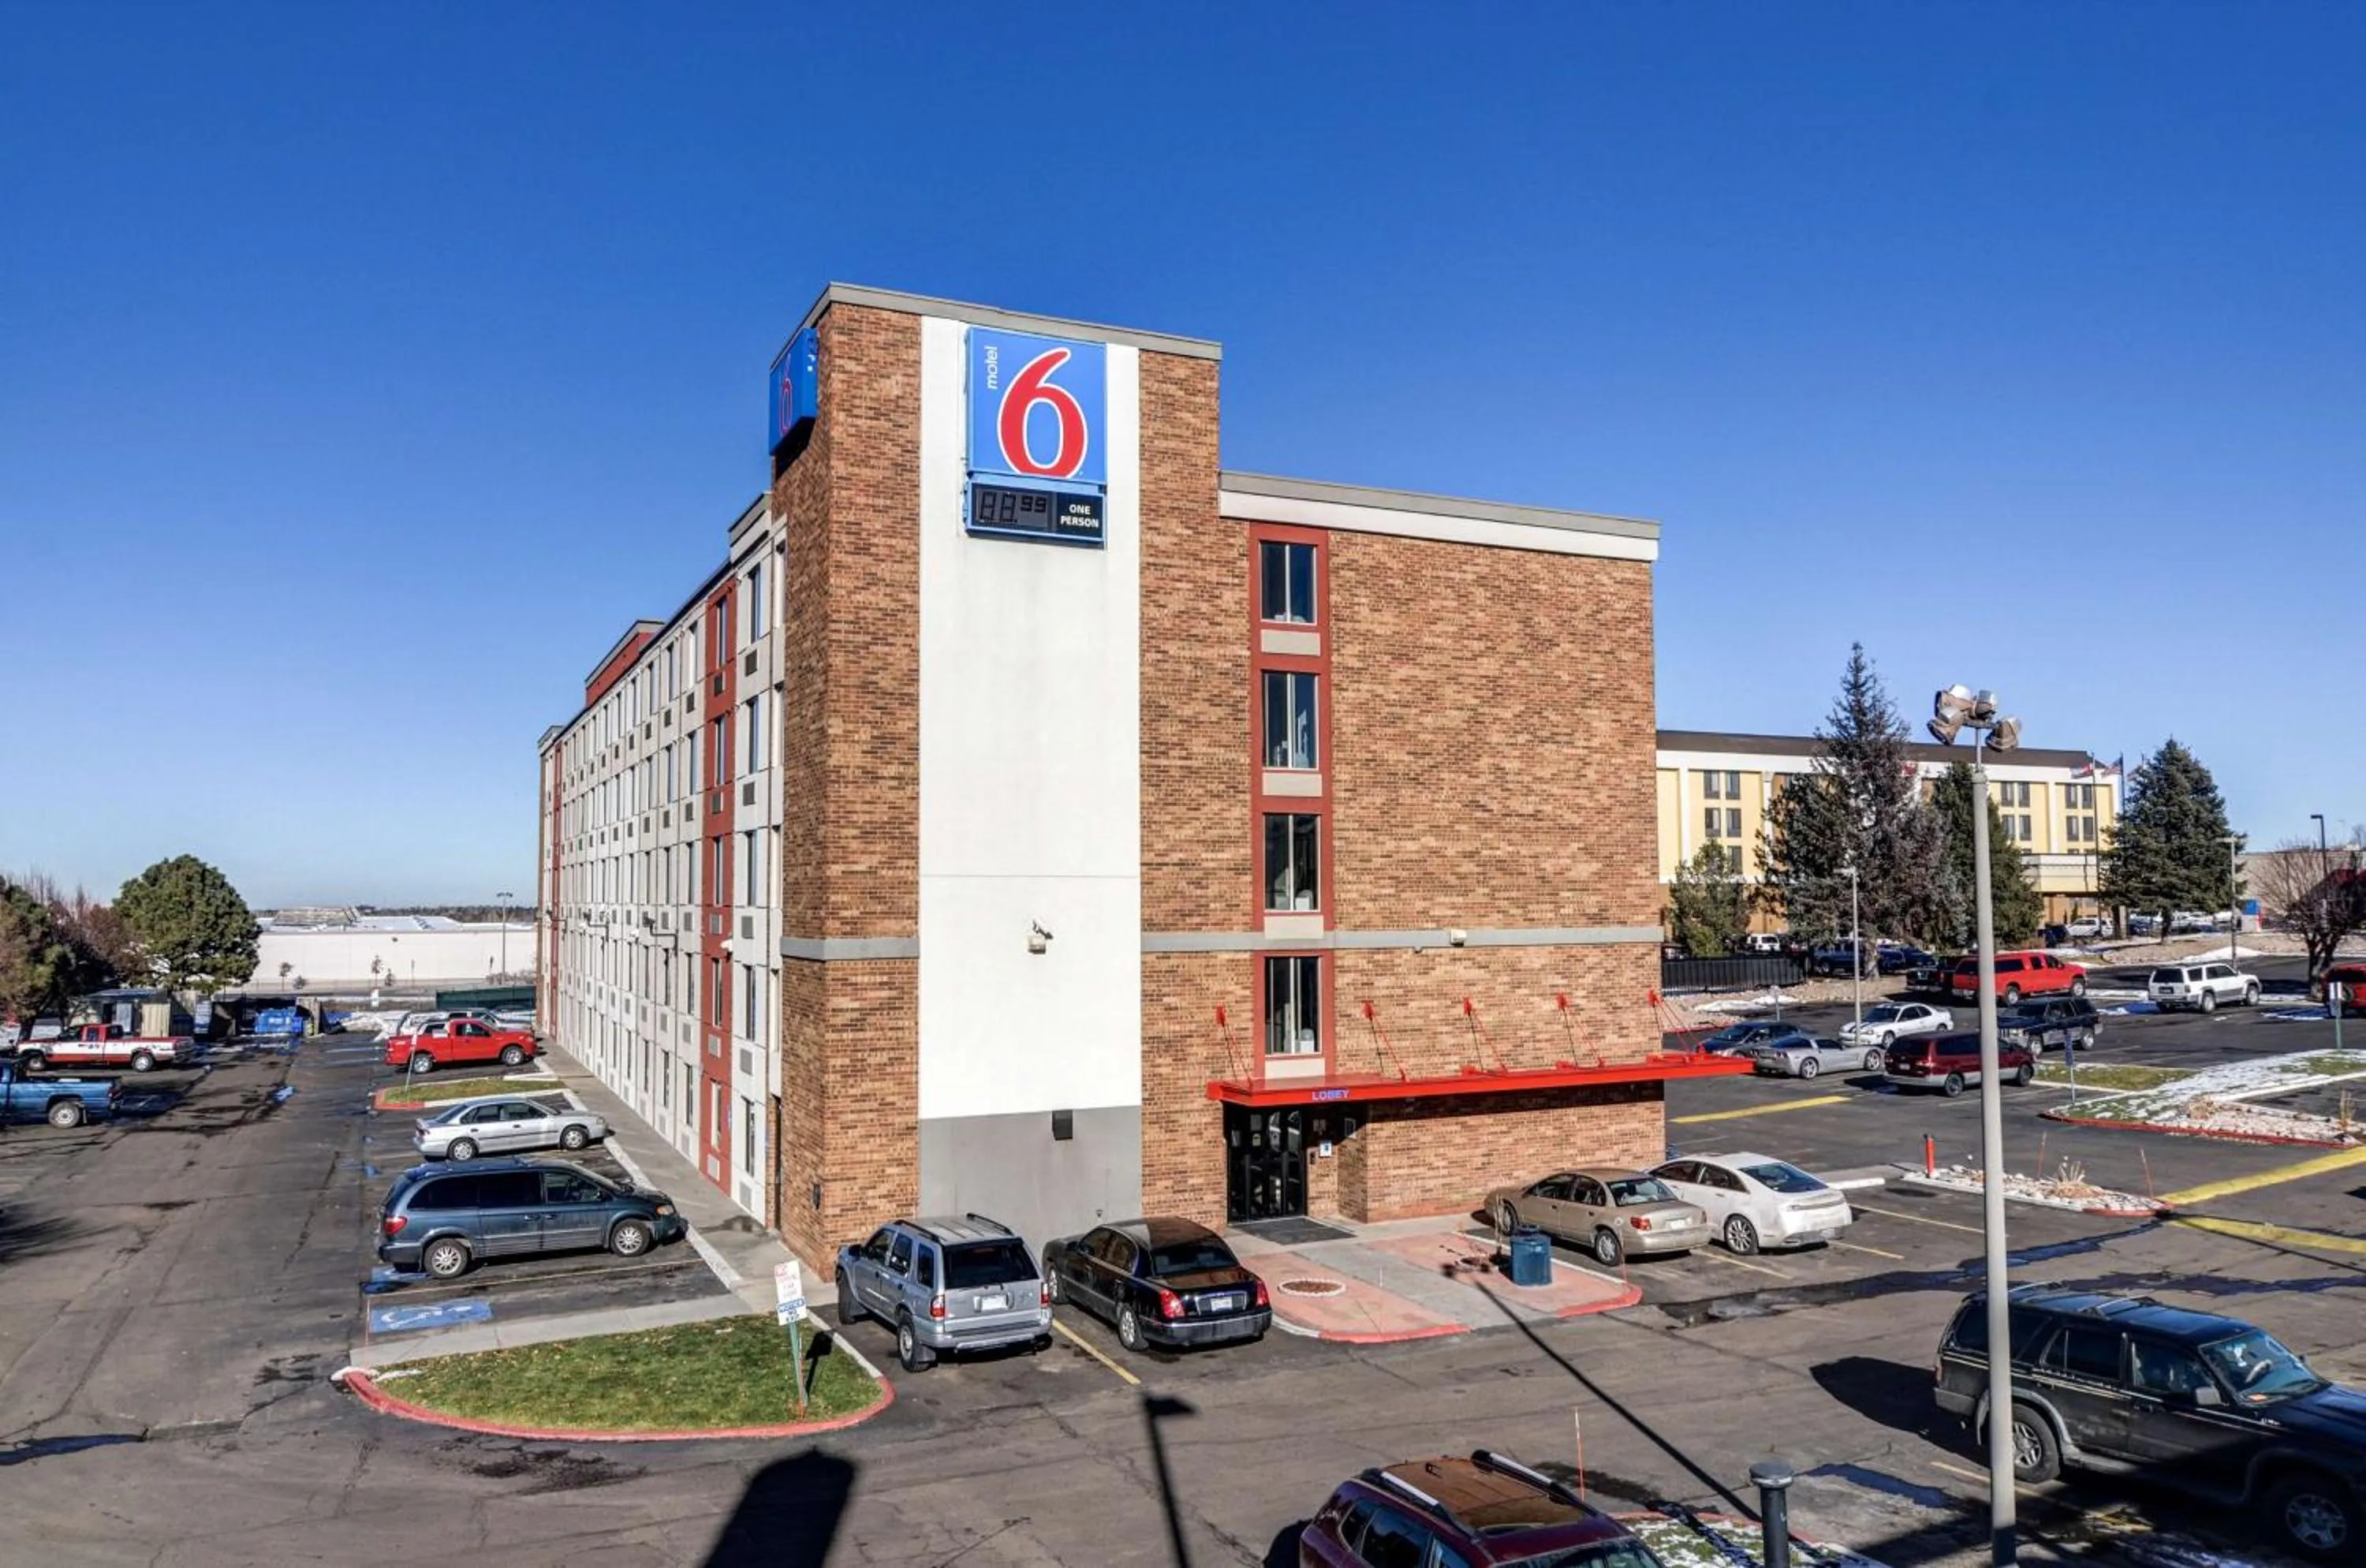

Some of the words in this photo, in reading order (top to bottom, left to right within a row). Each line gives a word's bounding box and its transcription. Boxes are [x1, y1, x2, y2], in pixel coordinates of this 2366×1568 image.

[984, 345, 998, 390] motel
[997, 347, 1088, 479] 6
[1069, 504, 1092, 515] ONE
[1060, 515, 1099, 528] PERSON
